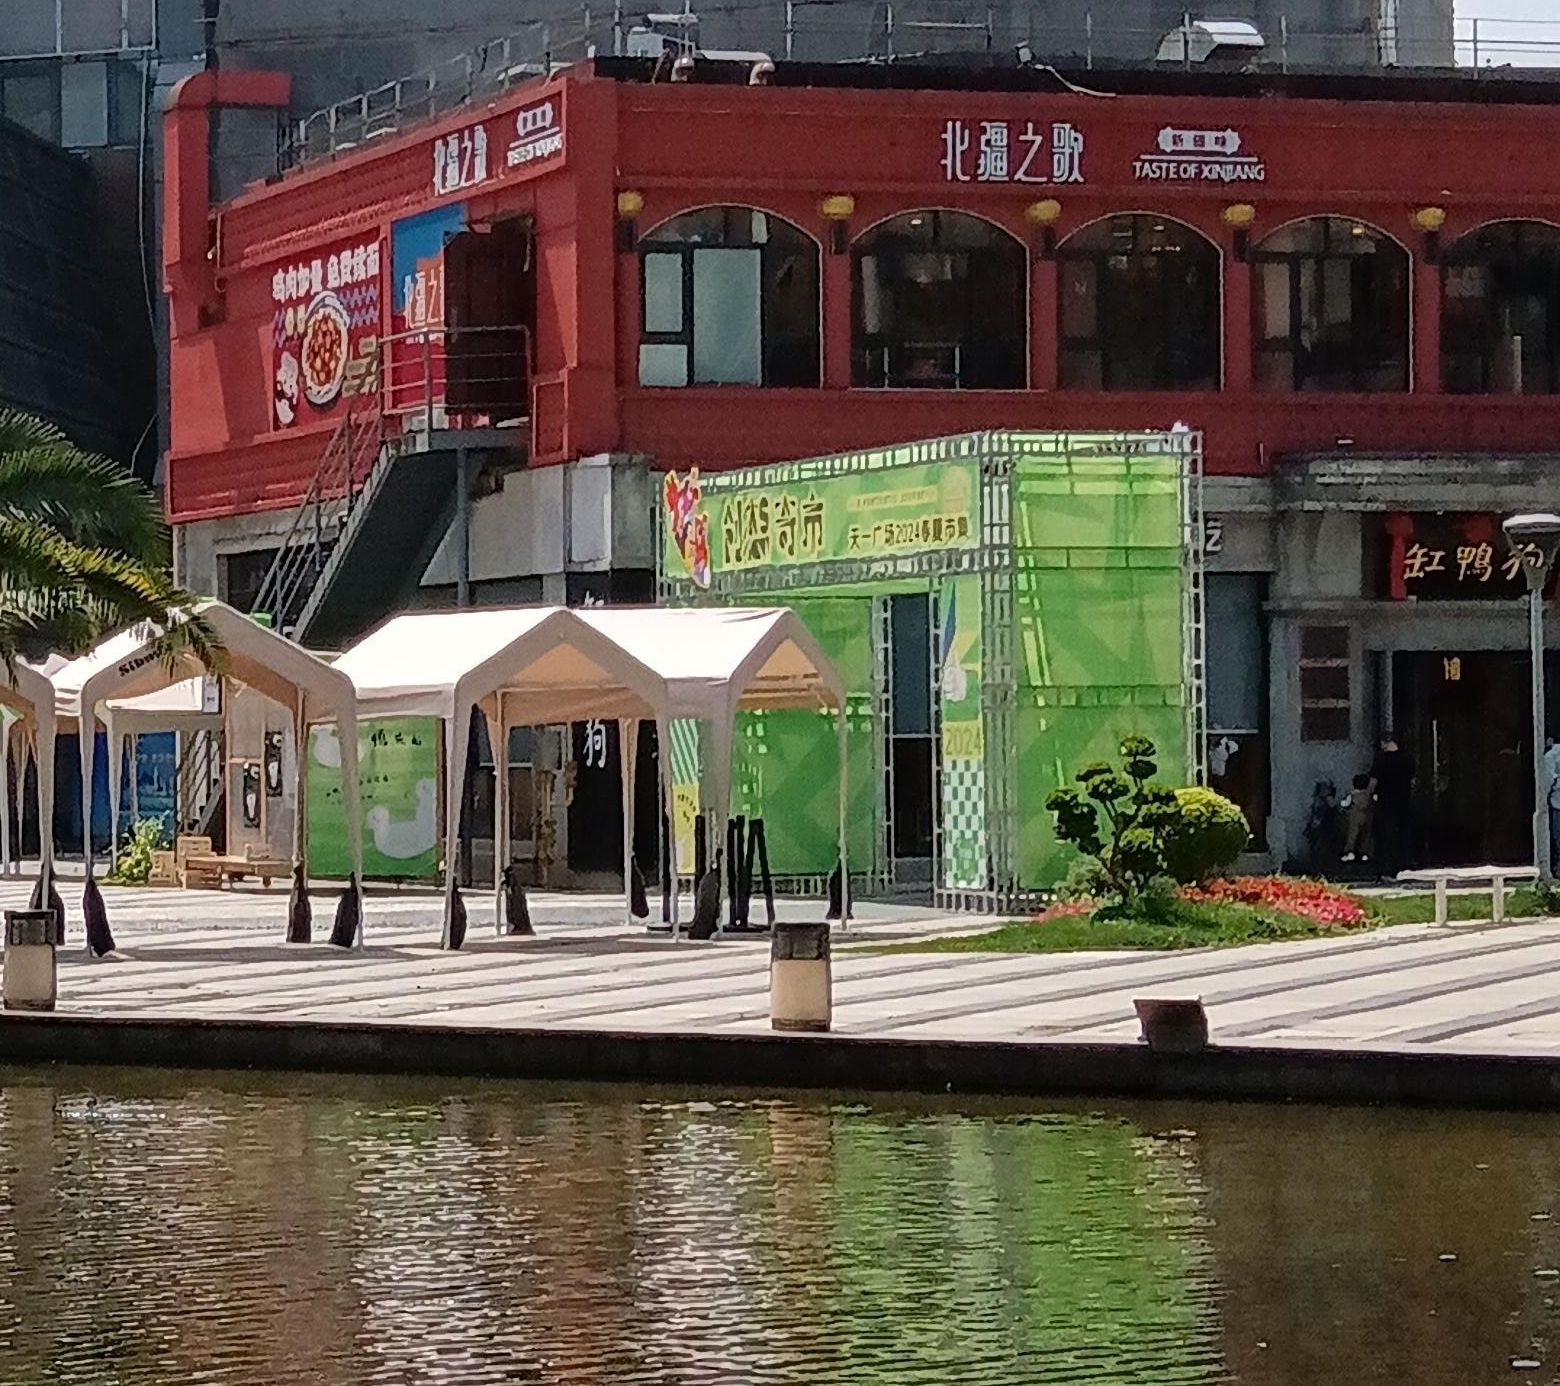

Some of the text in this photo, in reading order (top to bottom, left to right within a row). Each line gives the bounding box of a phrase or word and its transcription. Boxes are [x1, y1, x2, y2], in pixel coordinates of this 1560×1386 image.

[940, 121, 1085, 182] 北疆之歌
[1132, 162, 1265, 182] TASTE OF XINJIANG
[403, 266, 444, 330] 北疆之
[944, 727, 982, 756] 2024
